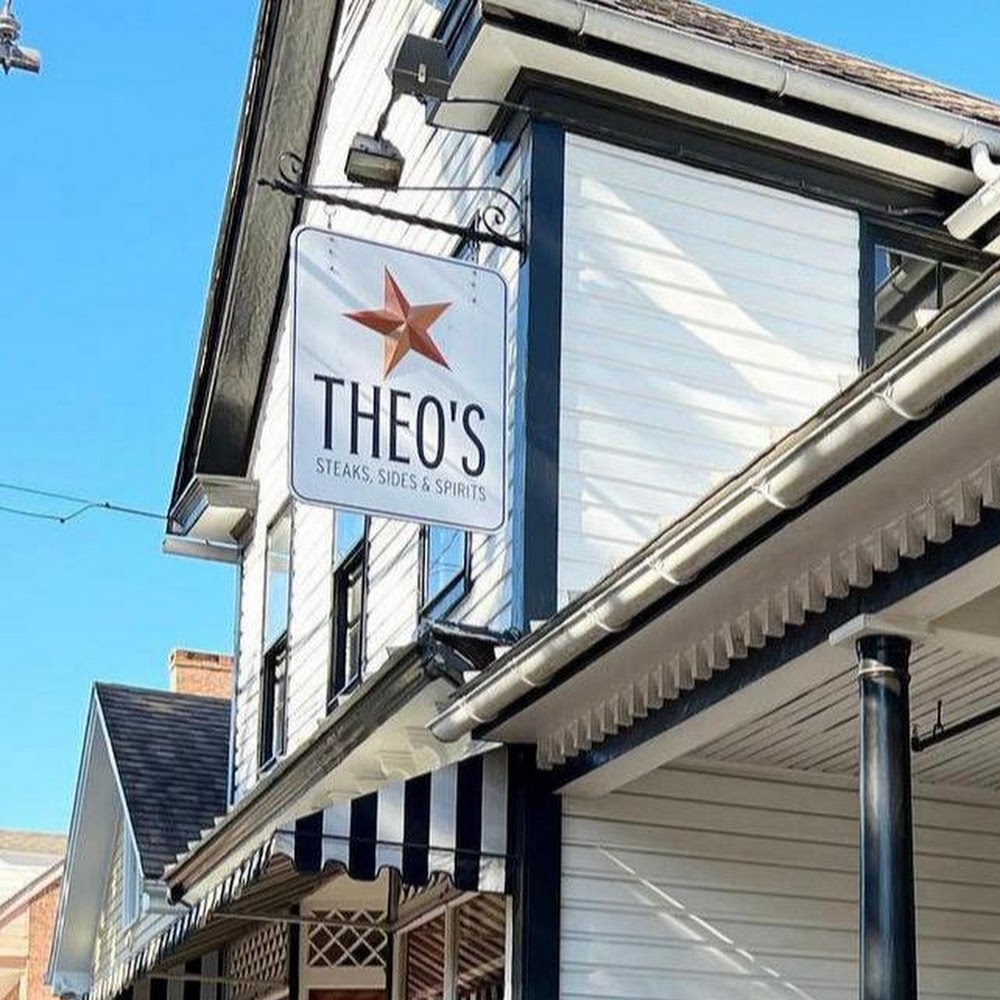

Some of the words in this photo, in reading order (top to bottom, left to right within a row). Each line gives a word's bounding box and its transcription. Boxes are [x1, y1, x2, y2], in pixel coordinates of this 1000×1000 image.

[314, 374, 485, 477] THEO'S
[315, 457, 373, 484] STEAKS,
[378, 468, 417, 490] SIDES
[422, 476, 430, 492] &
[435, 478, 487, 501] SPIRITS
